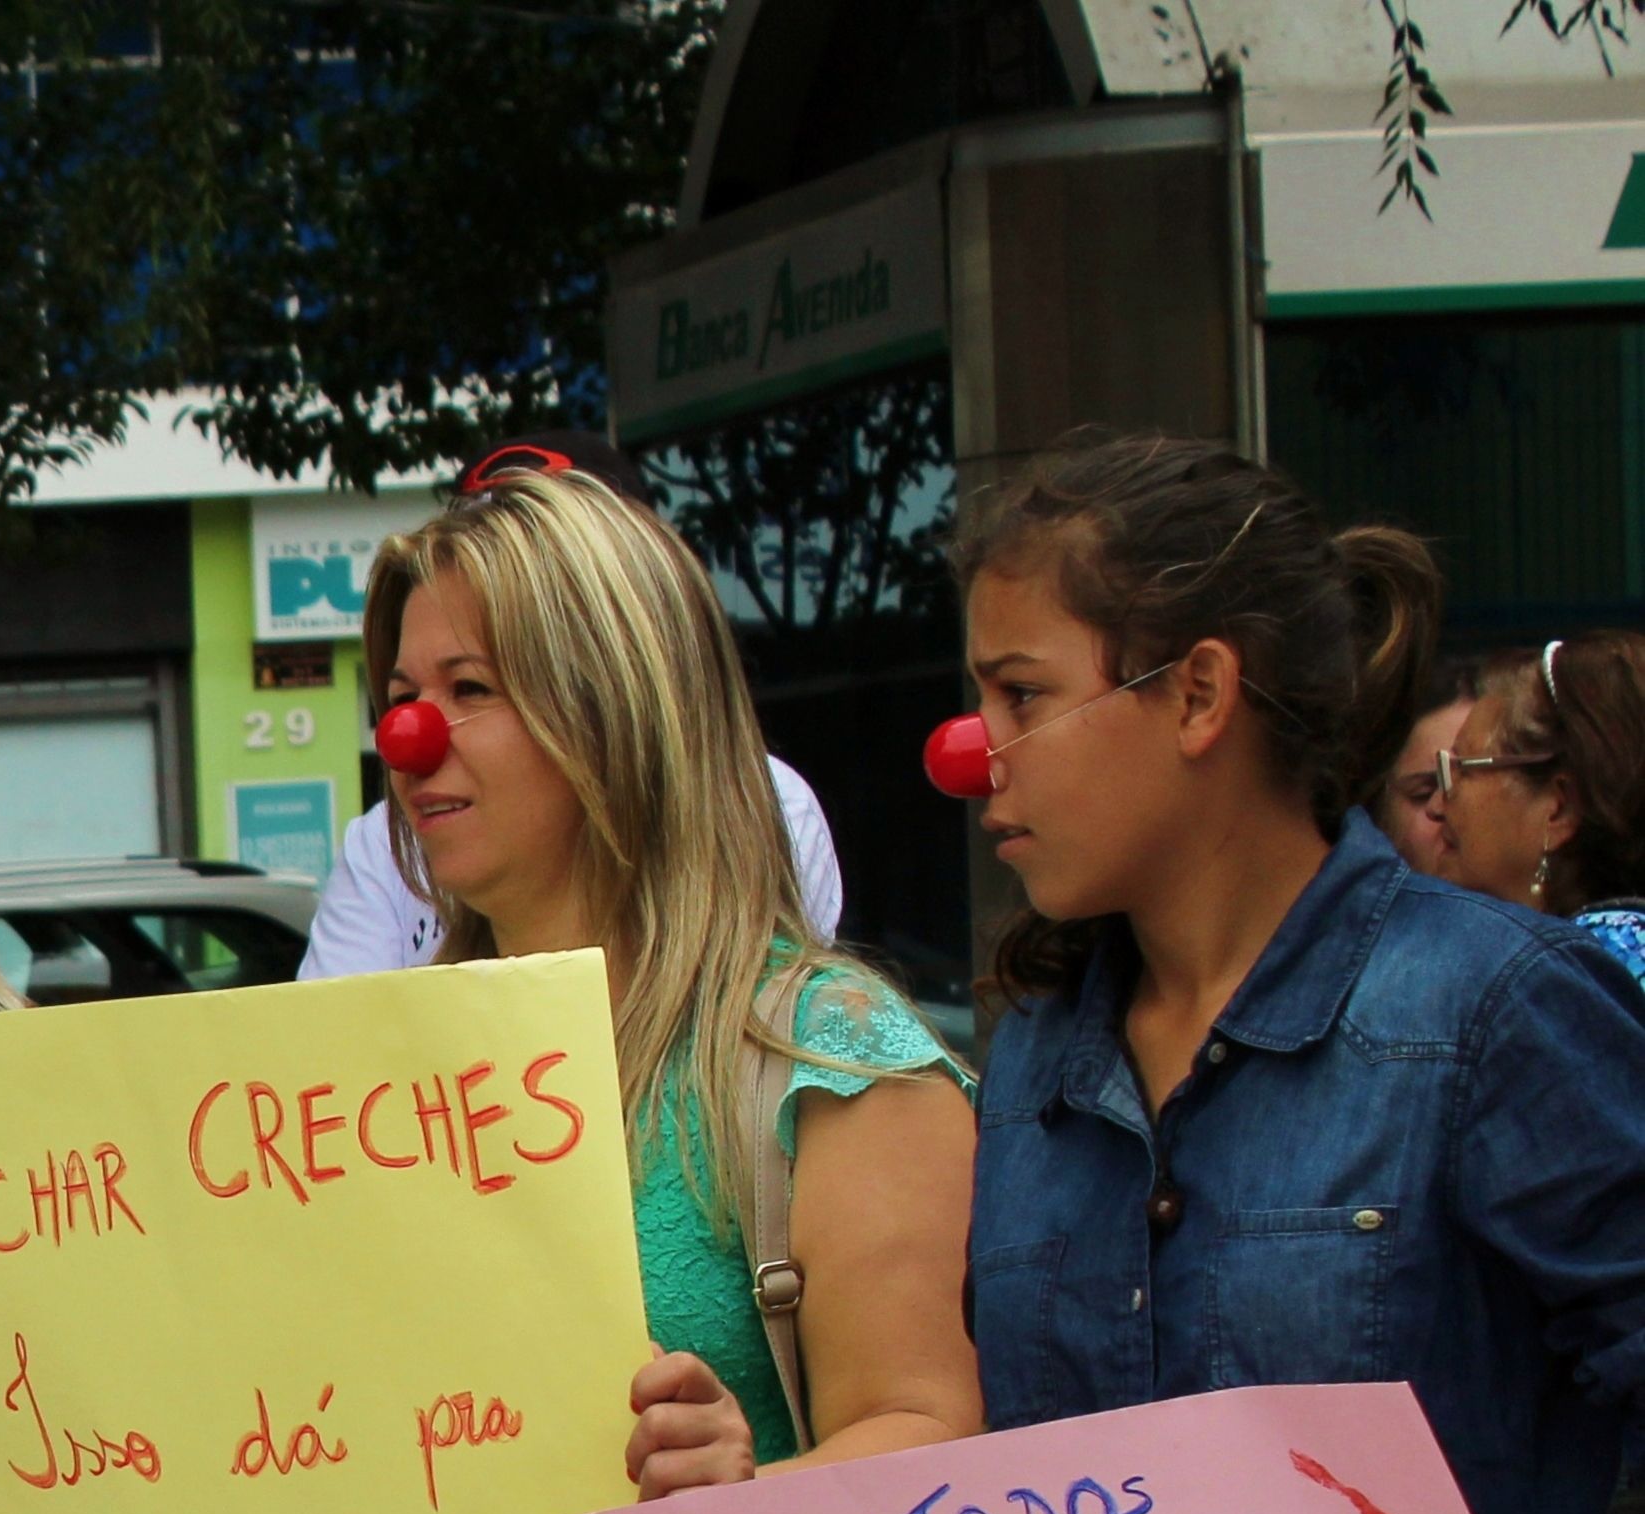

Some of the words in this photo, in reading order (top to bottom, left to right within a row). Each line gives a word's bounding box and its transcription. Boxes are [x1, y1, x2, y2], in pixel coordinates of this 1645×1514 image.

[244, 707, 315, 749] 29
[188, 1050, 585, 1206] CRECHES
[4, 1332, 162, 1489] Isso
[230, 1384, 348, 1478] dá
[416, 1391, 524, 1511] pra
